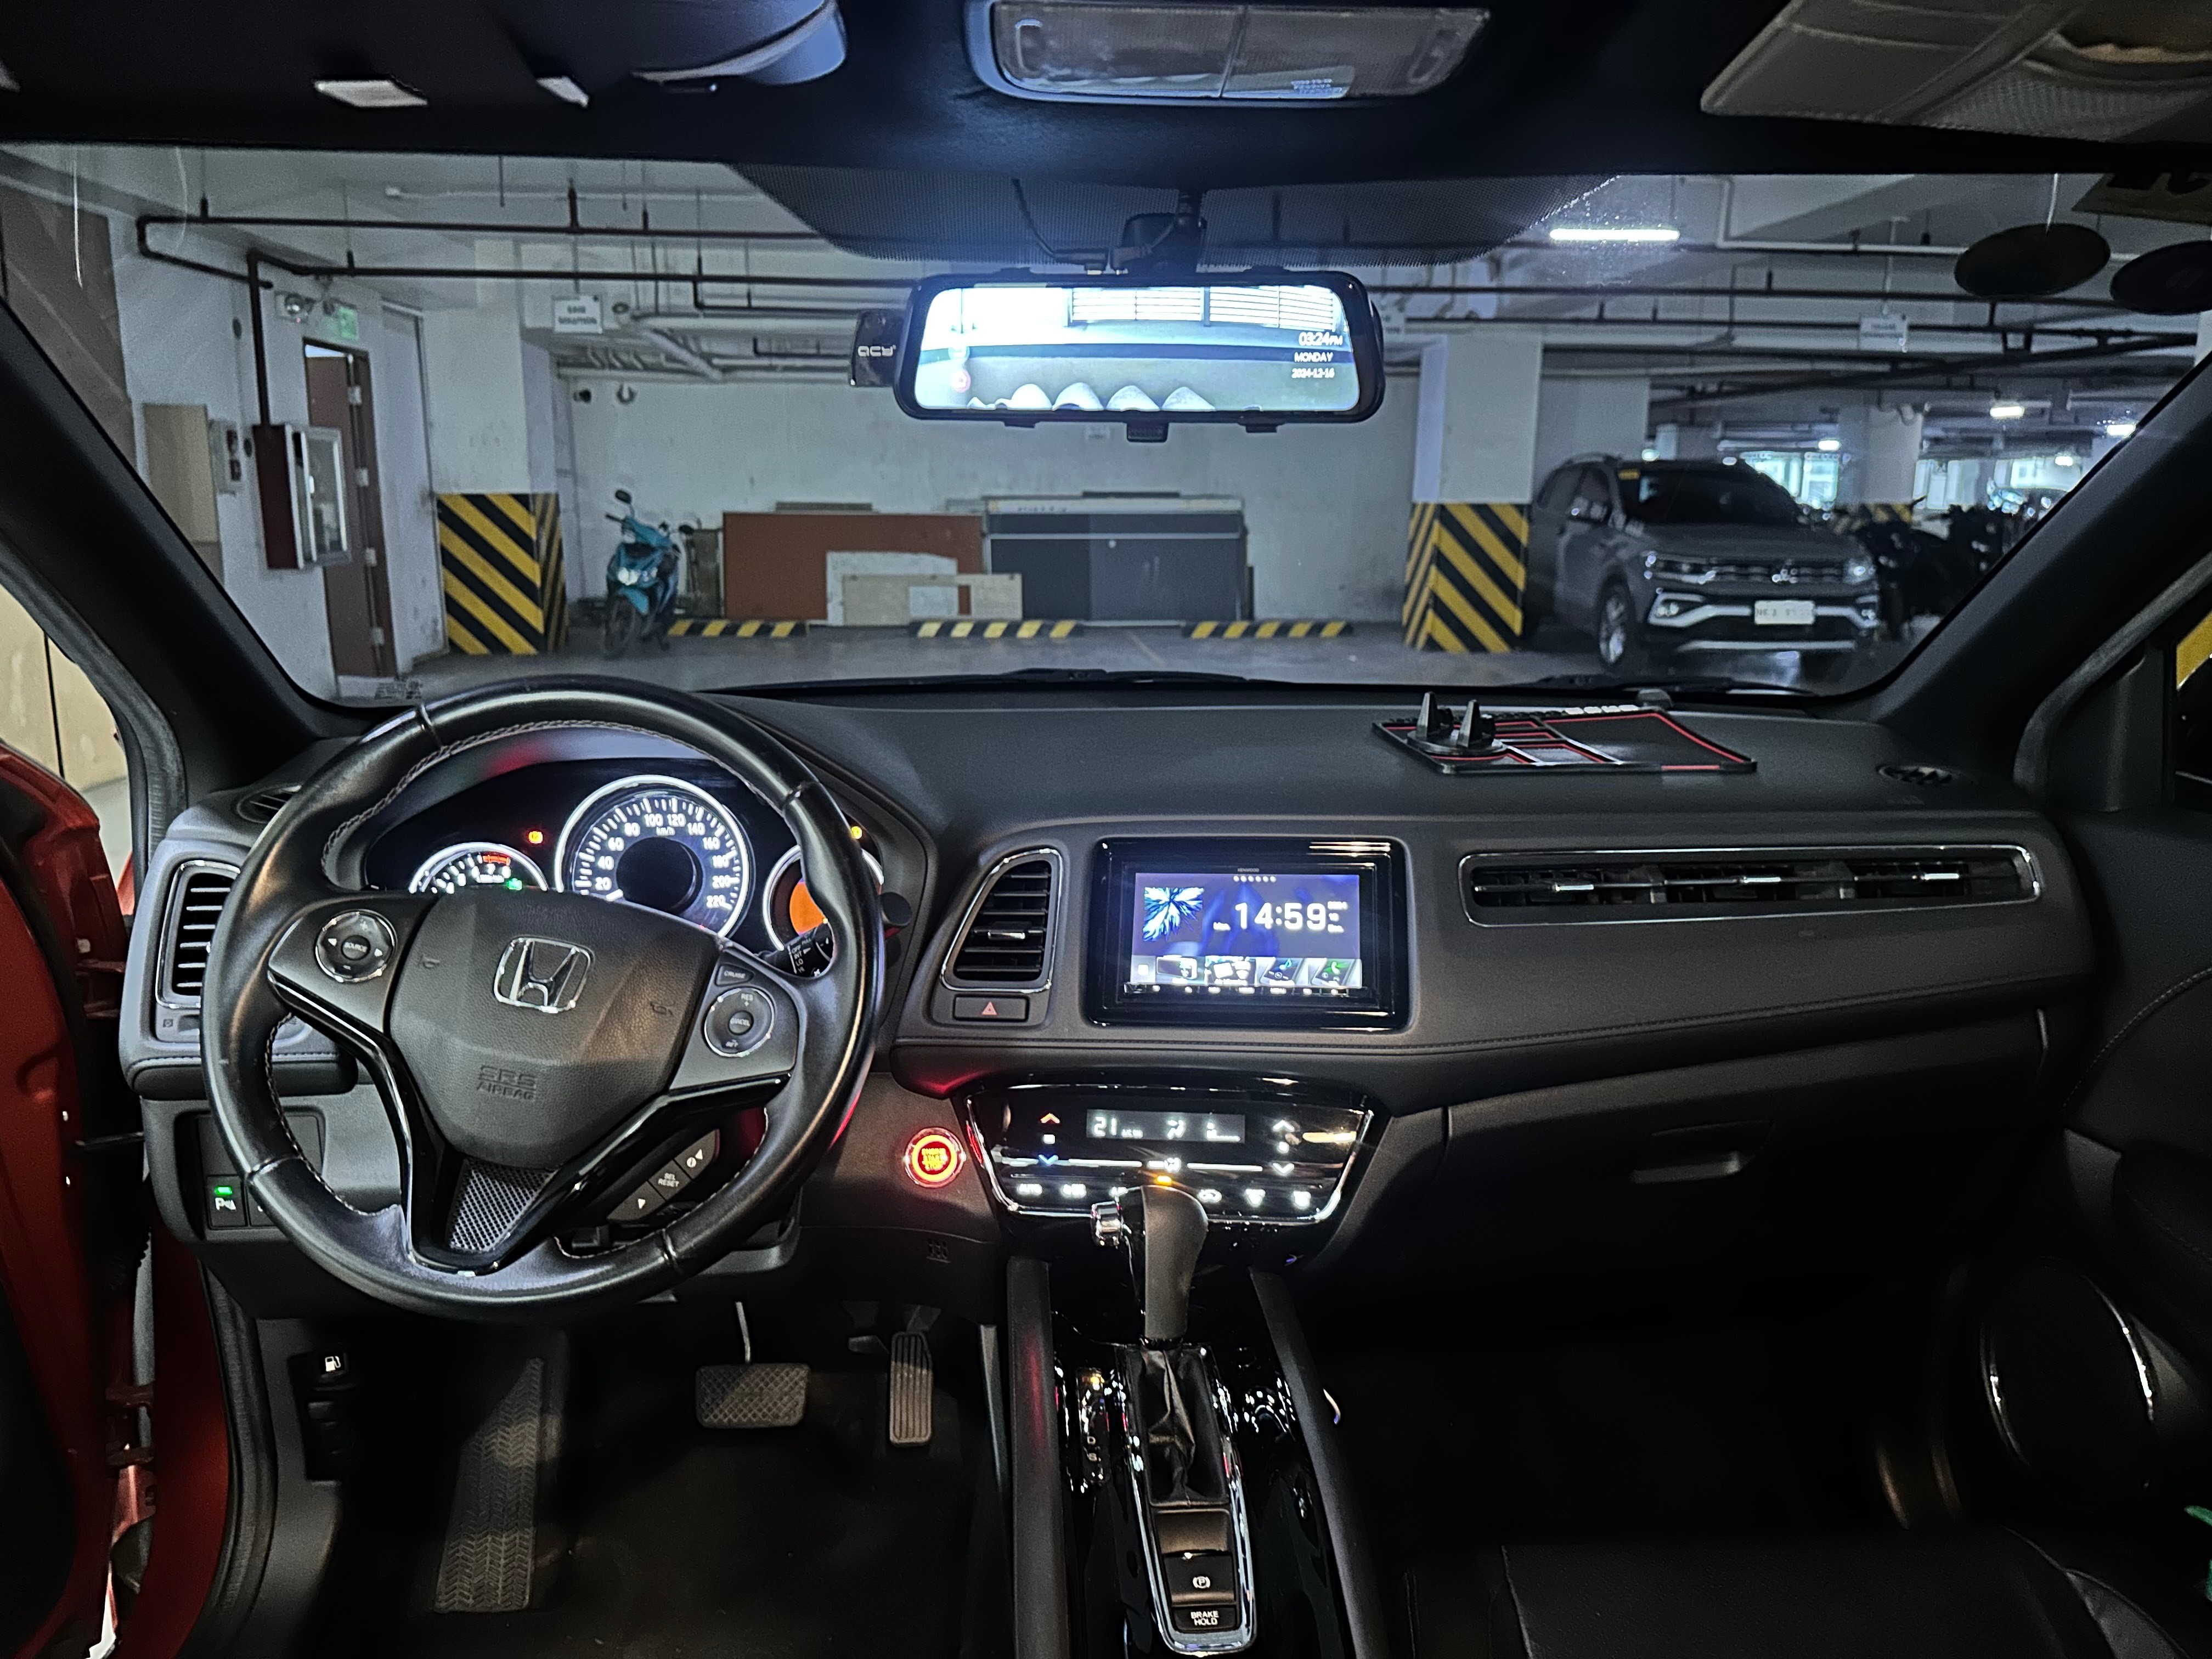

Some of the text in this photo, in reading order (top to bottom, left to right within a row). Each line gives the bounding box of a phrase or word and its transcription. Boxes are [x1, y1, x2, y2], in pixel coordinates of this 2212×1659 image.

[1294, 352, 1334, 362] MONDAY
[1291, 368, 1335, 379] 2024-12-16
[644, 814, 686, 827] 100 120
[624, 823, 640, 837] 80
[656, 827, 675, 836] km/h
[688, 823, 705, 836] 140
[608, 837, 624, 851] 60
[703, 837, 720, 850] 160
[597, 856, 614, 871] 40
[712, 855, 730, 868] 180
[595, 877, 612, 891] 20
[712, 874, 731, 889] 200
[706, 894, 726, 909] 220
[1235, 902, 1326, 931] 14:59
[344, 942, 368, 953] SOURCE
[791, 944, 801, 954] OFF
[794, 950, 802, 960] INT
[795, 958, 804, 967] LO
[724, 970, 746, 979] CRUISE
[730, 1018, 751, 1027] CANCEL
[479, 1065, 536, 1087] SRS
[476, 1081, 536, 1100] AIRBAG
[1094, 1116, 1117, 1137] 21
[658, 1178, 680, 1187] RESET
[664, 1172, 676, 1181] SEL
[1019, 1183, 1042, 1195] AUTO
[1087, 1436, 1096, 1445] D
[1190, 1610, 1220, 1620] BRAKE
[1194, 1617, 1218, 1626] HOLD
